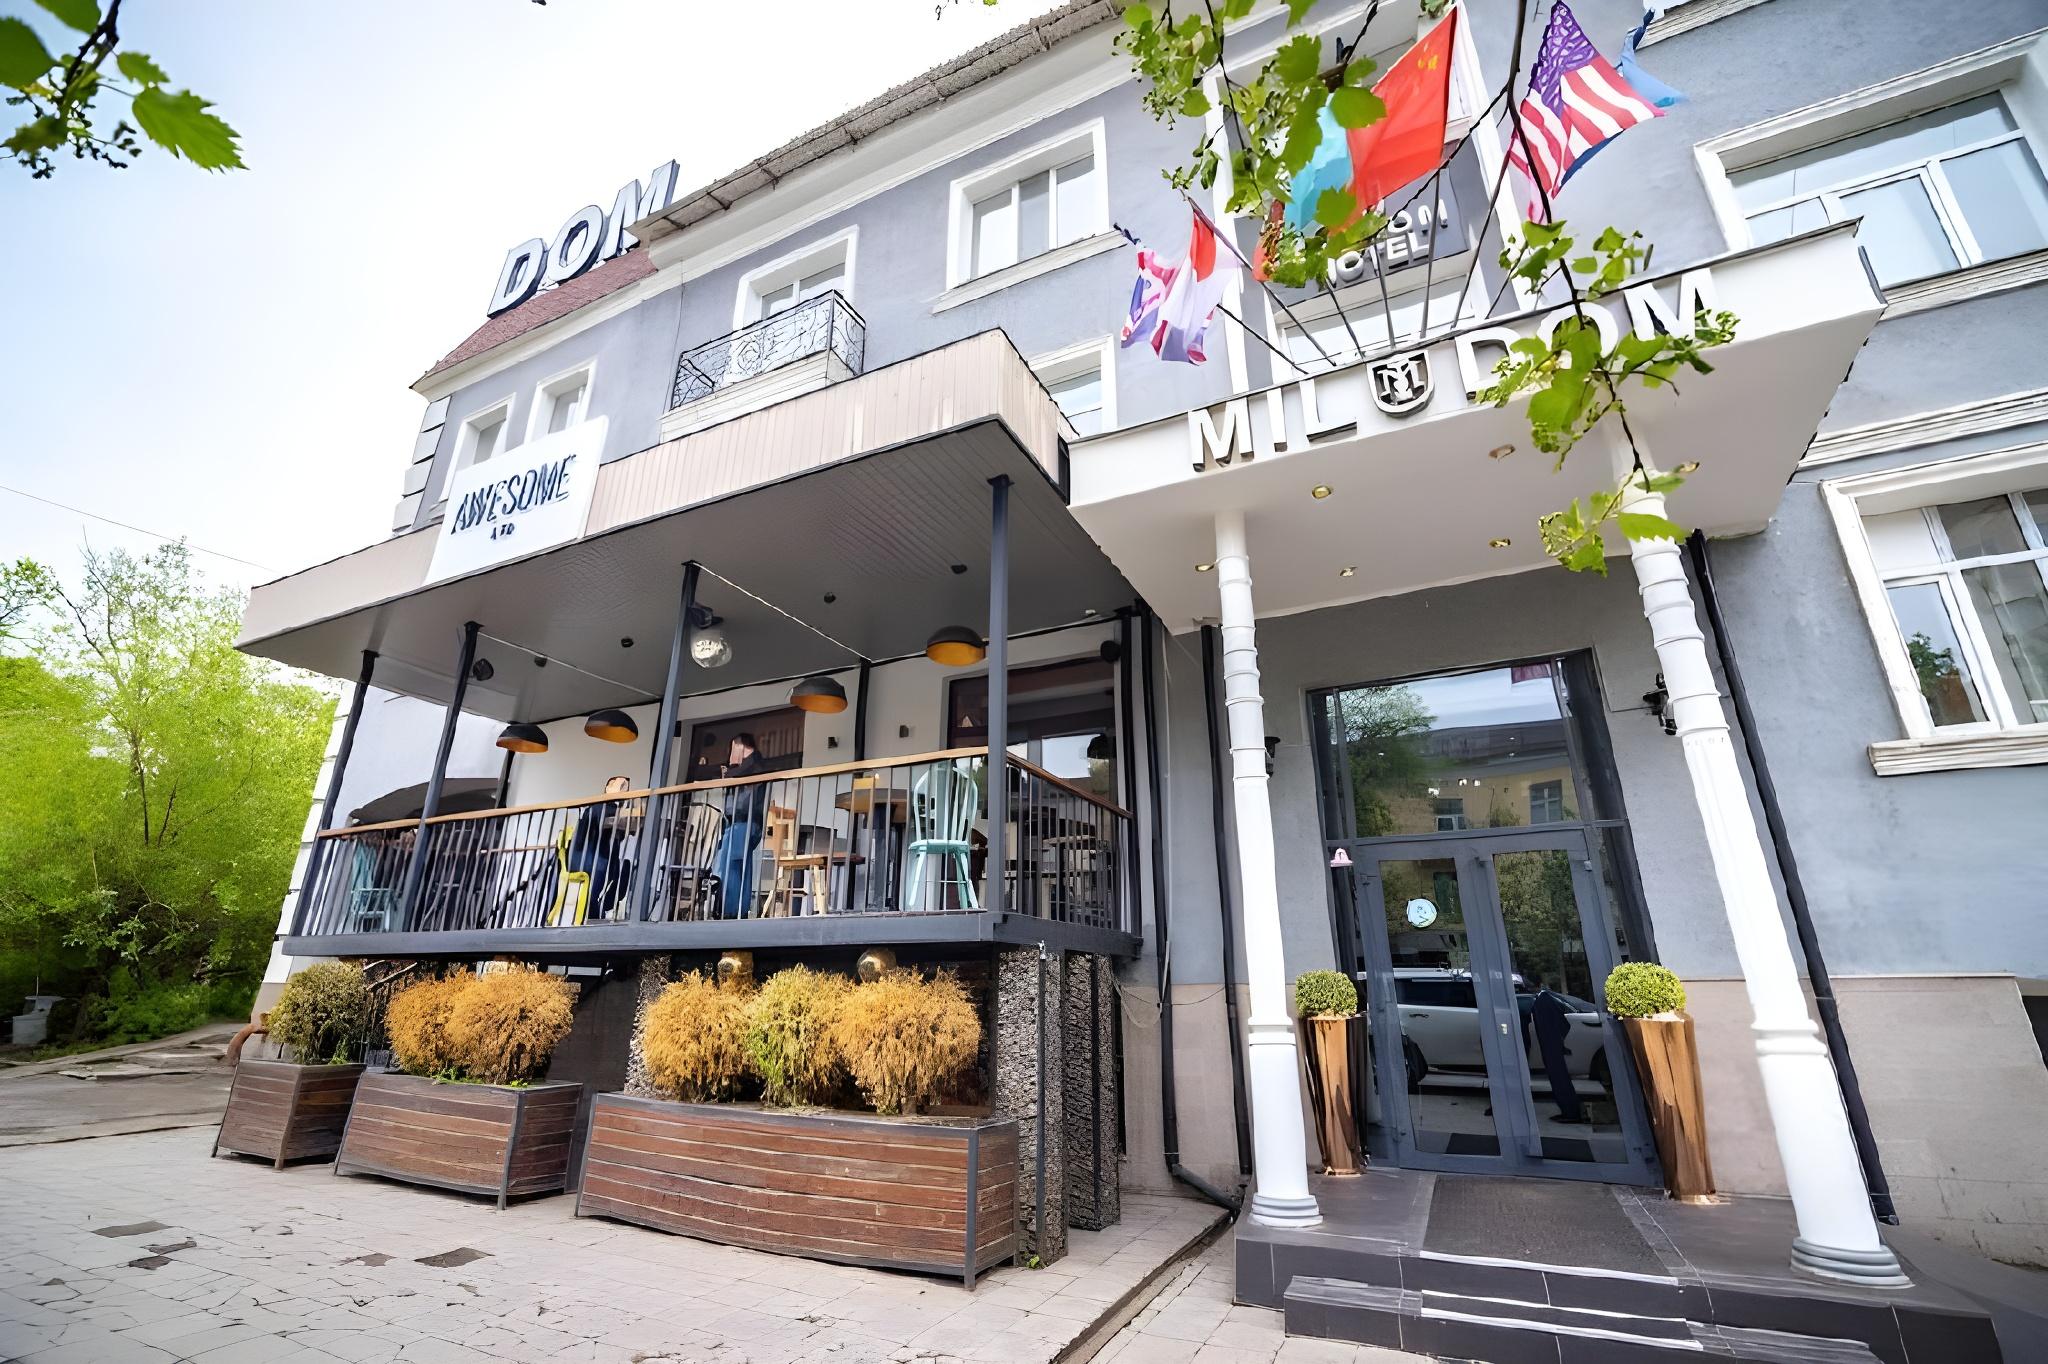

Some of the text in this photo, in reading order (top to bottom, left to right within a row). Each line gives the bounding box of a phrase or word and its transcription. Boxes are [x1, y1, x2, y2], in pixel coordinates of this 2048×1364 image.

[487, 159, 680, 318] DOM
[1186, 378, 1357, 472] MIL
[1455, 267, 1726, 400] DOM
[451, 454, 577, 535] AWESOME
